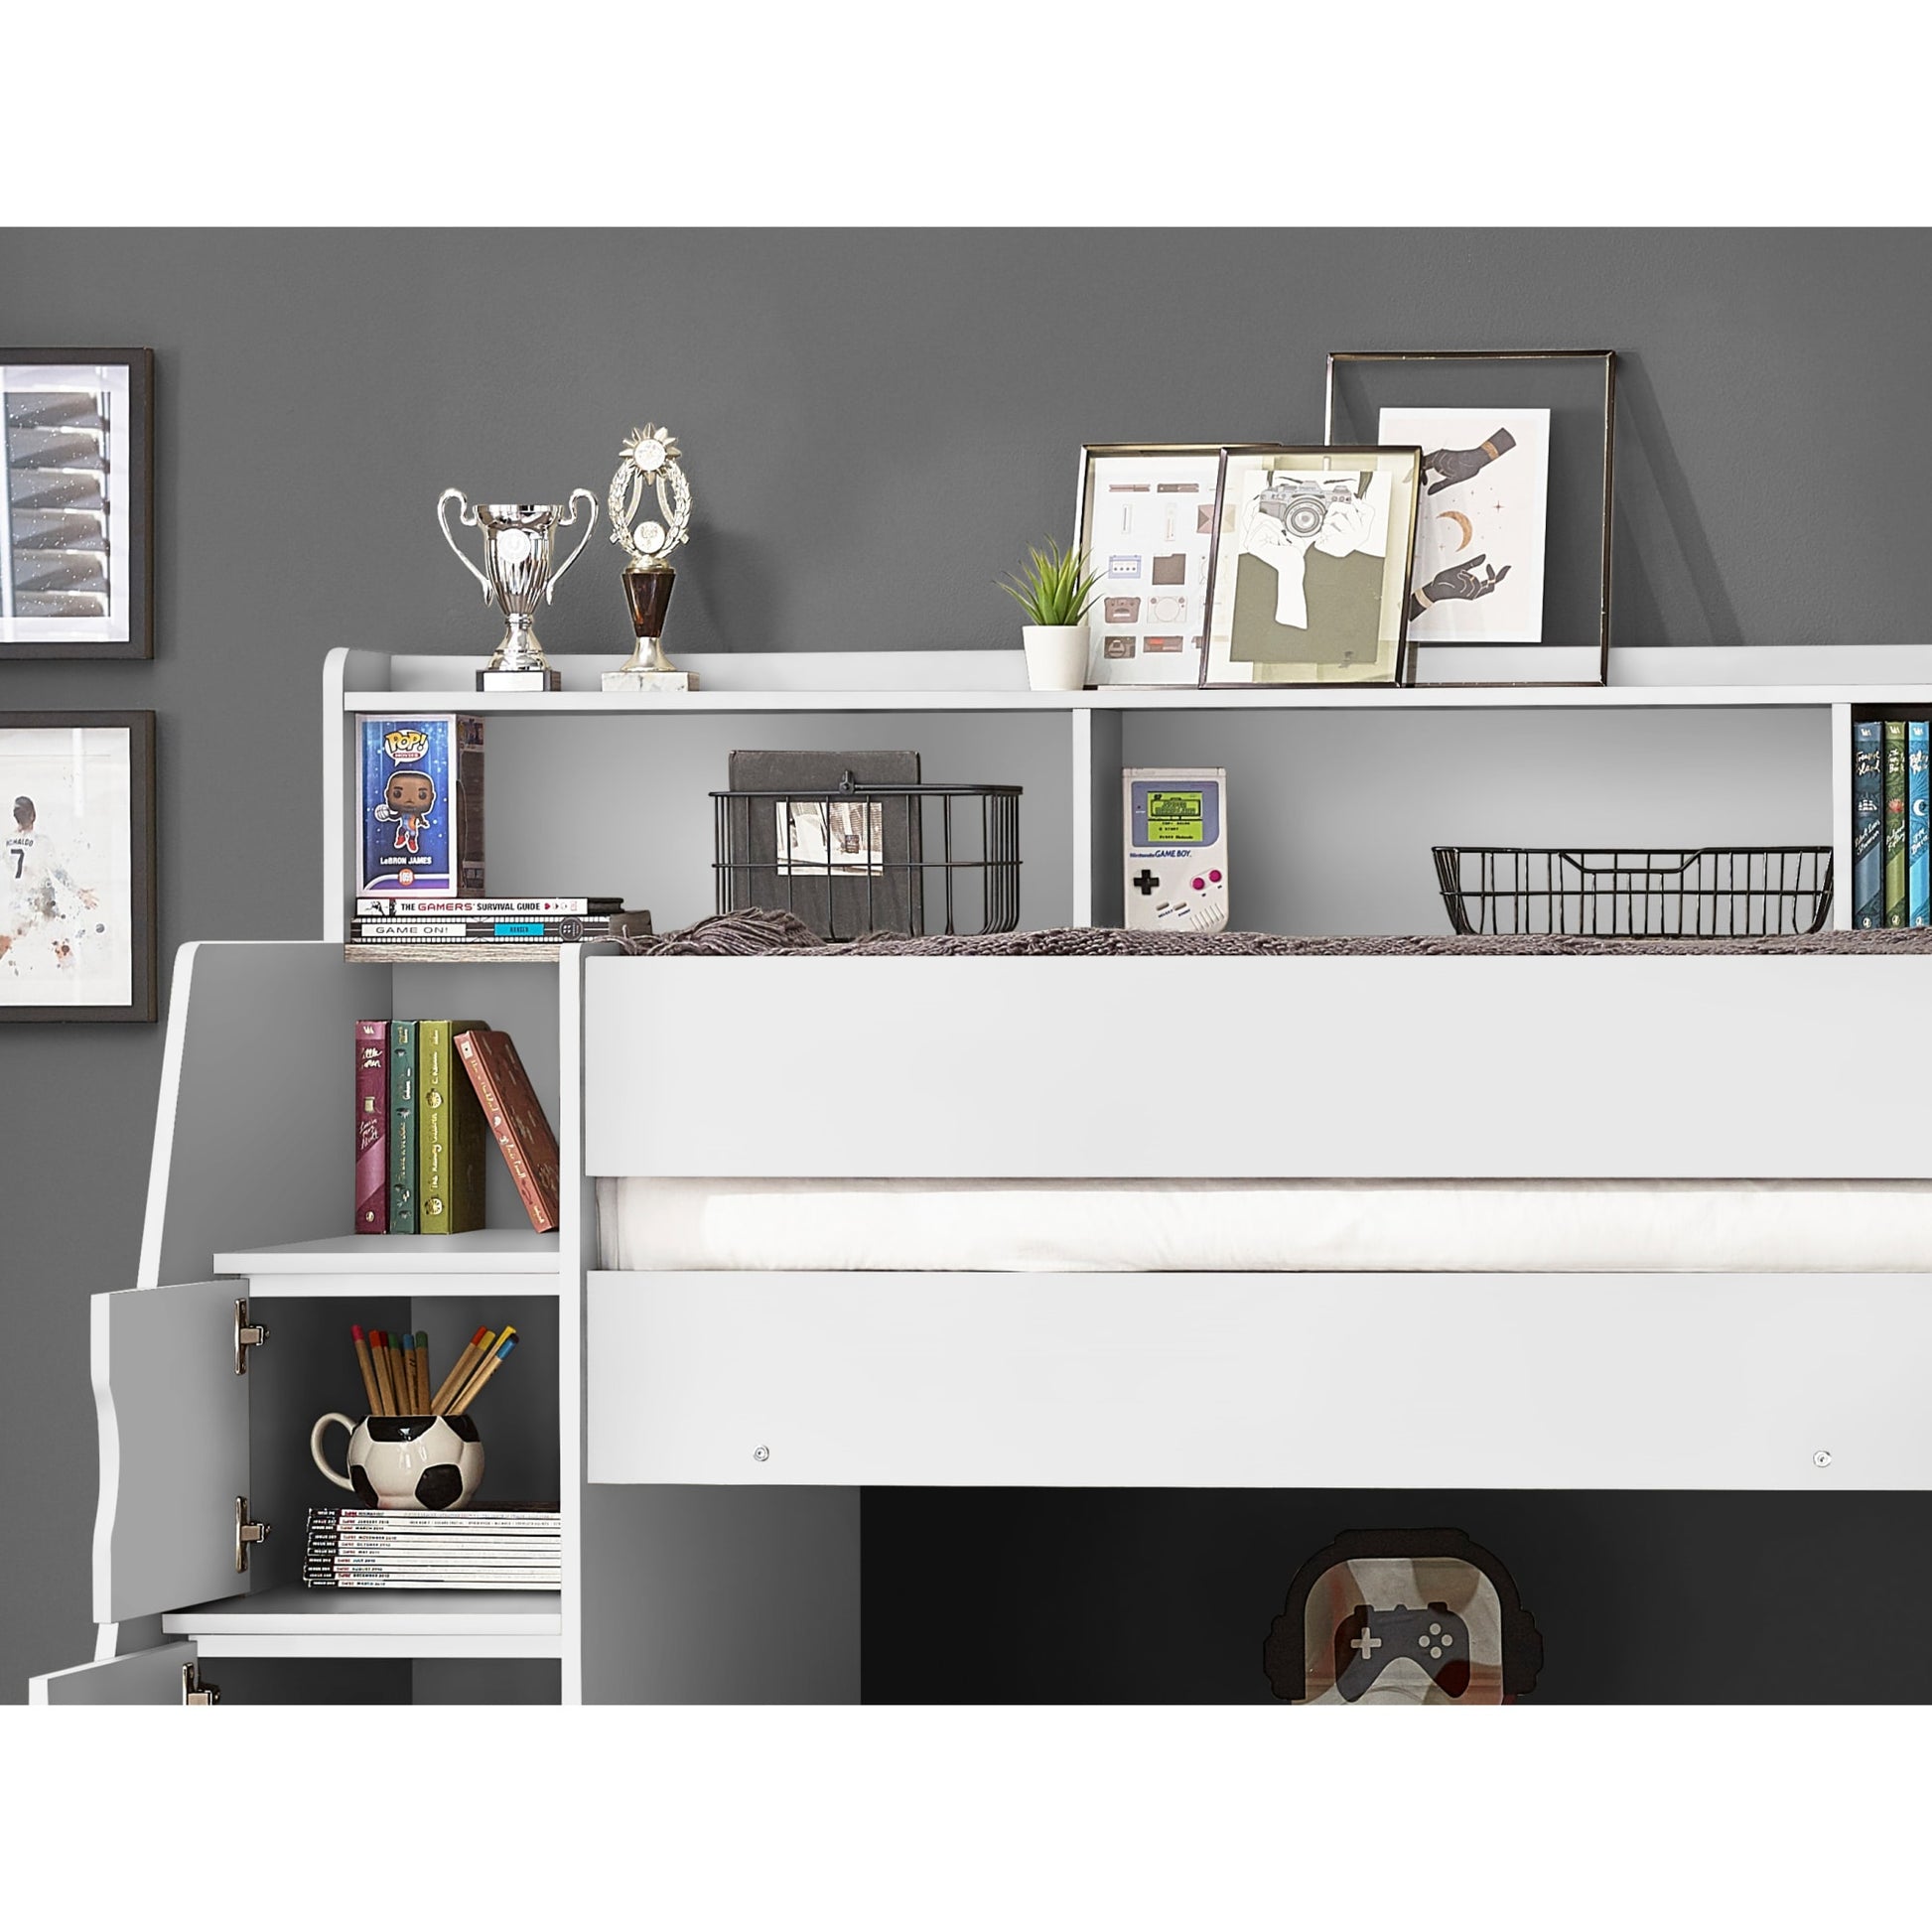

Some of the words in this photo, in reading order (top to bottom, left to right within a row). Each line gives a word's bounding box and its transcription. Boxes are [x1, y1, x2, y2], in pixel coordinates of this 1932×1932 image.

[384, 732, 428, 754] POP!
[1155, 849, 1175, 858] GAME
[1176, 849, 1190, 858] BOY
[10, 848, 25, 879] 7
[379, 856, 407, 865] LeBRON
[408, 856, 432, 865] JAMES
[401, 902, 415, 911] THE
[477, 902, 514, 911] SURVIVAL
[516, 902, 540, 911] GUIDE
